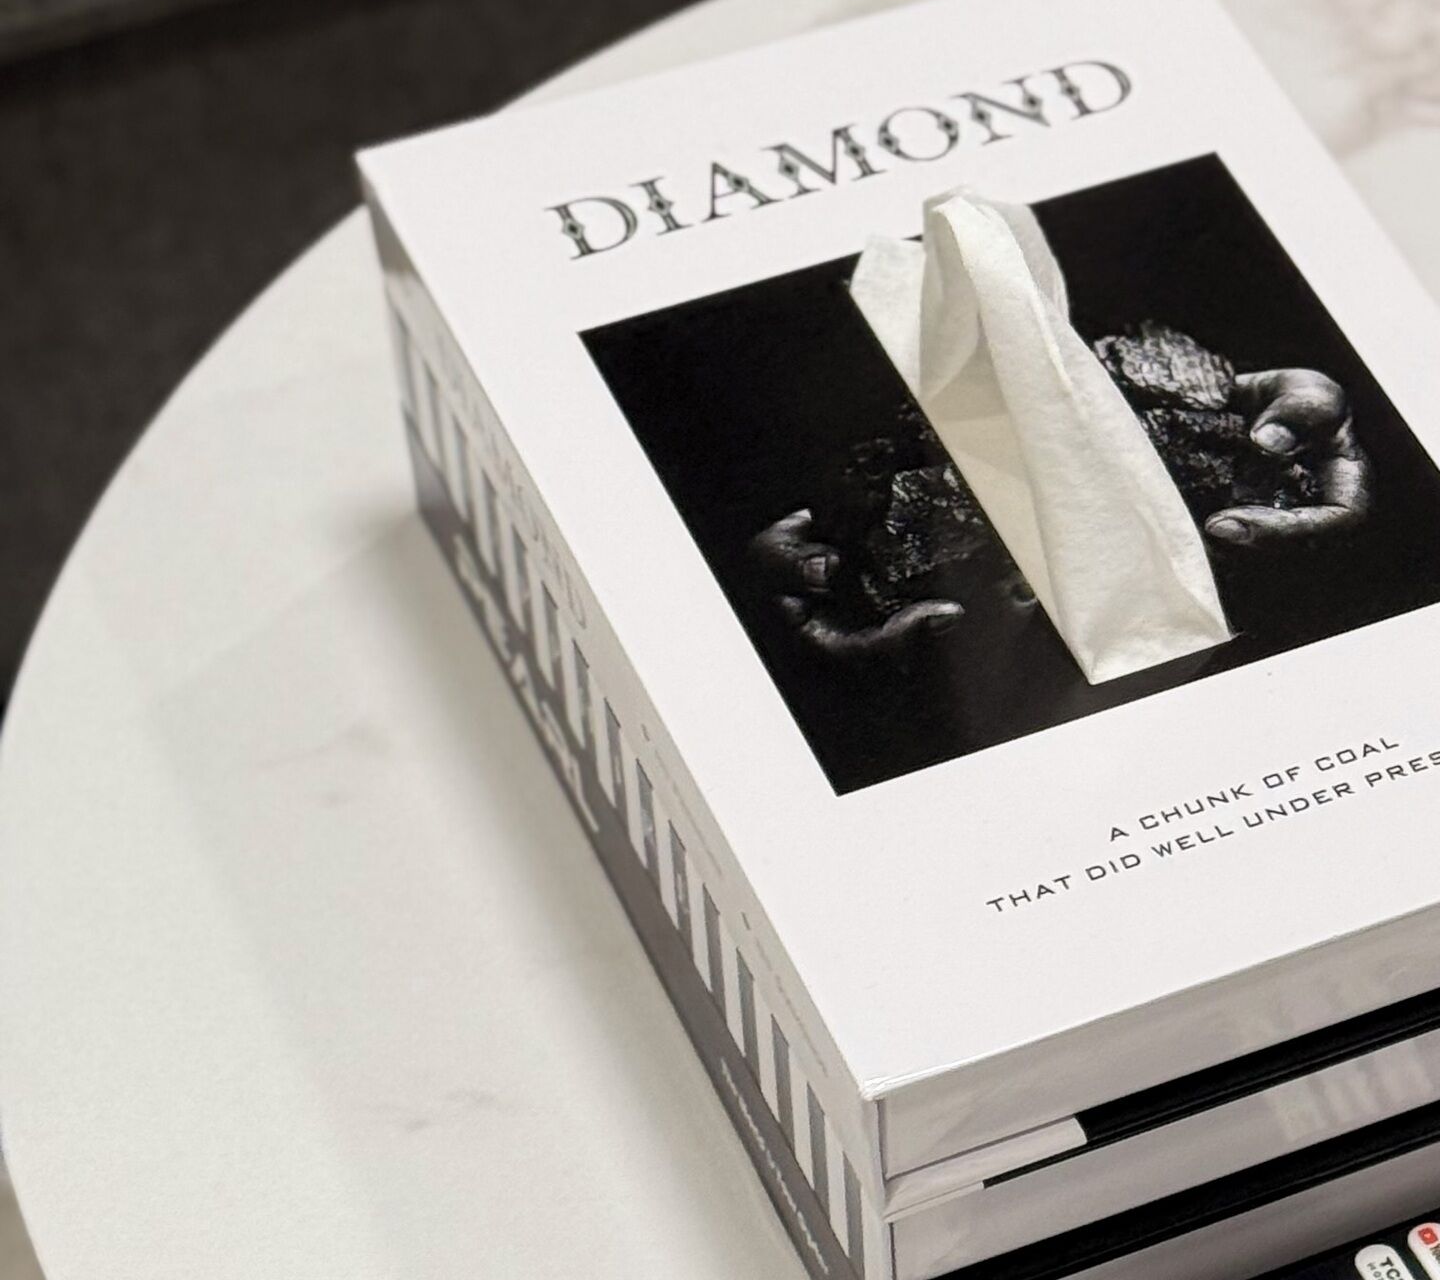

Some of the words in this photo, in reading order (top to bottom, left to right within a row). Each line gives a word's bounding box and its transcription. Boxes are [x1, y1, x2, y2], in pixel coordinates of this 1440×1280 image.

[545, 59, 1132, 260] DIAMOND
[986, 875, 1072, 912] THAT
[1086, 854, 1142, 881] DID
[1151, 825, 1234, 858] WELL
[1243, 784, 1354, 828] UNDER
[1108, 826, 1129, 842] A
[1139, 784, 1254, 830] CHUNK
[1262, 768, 1301, 790] OF
[1315, 737, 1401, 773] COAL
